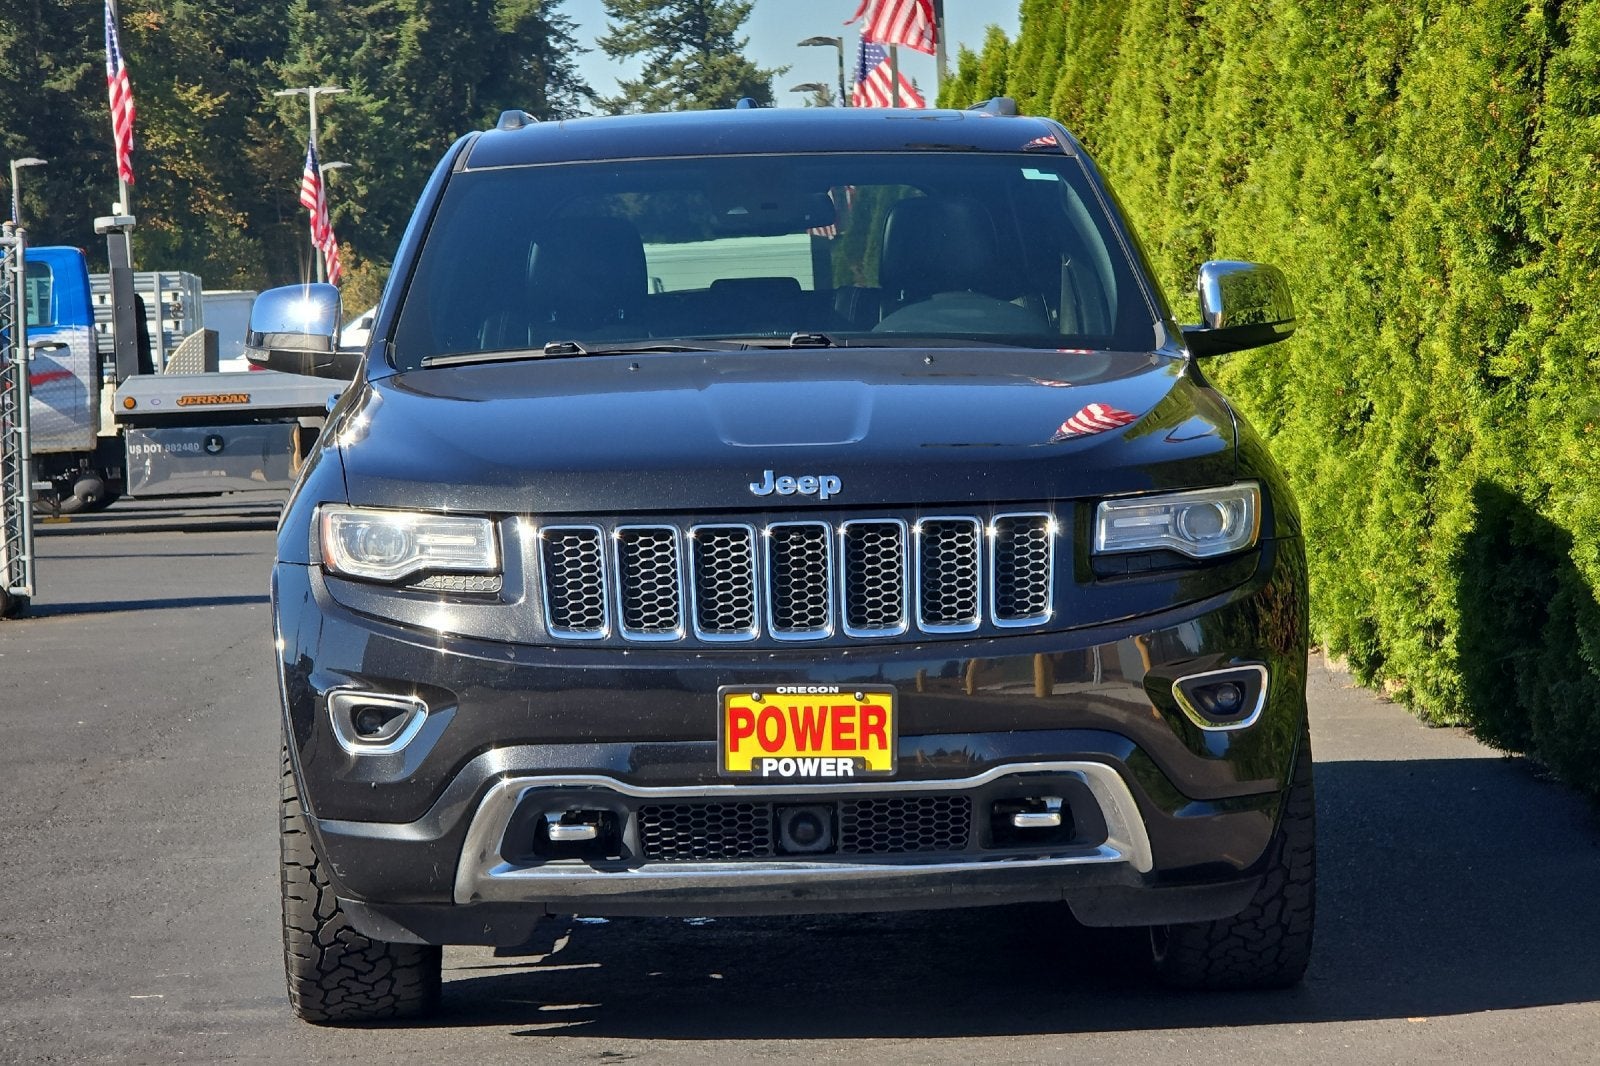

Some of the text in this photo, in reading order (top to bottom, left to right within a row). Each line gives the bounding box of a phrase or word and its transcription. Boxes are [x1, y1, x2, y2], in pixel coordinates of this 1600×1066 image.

[129, 444, 142, 454] US
[143, 443, 162, 453] DOT
[749, 470, 842, 500] Jeep
[776, 686, 839, 694] OREGON
[729, 705, 888, 752] POWER
[762, 758, 854, 776] POWER
